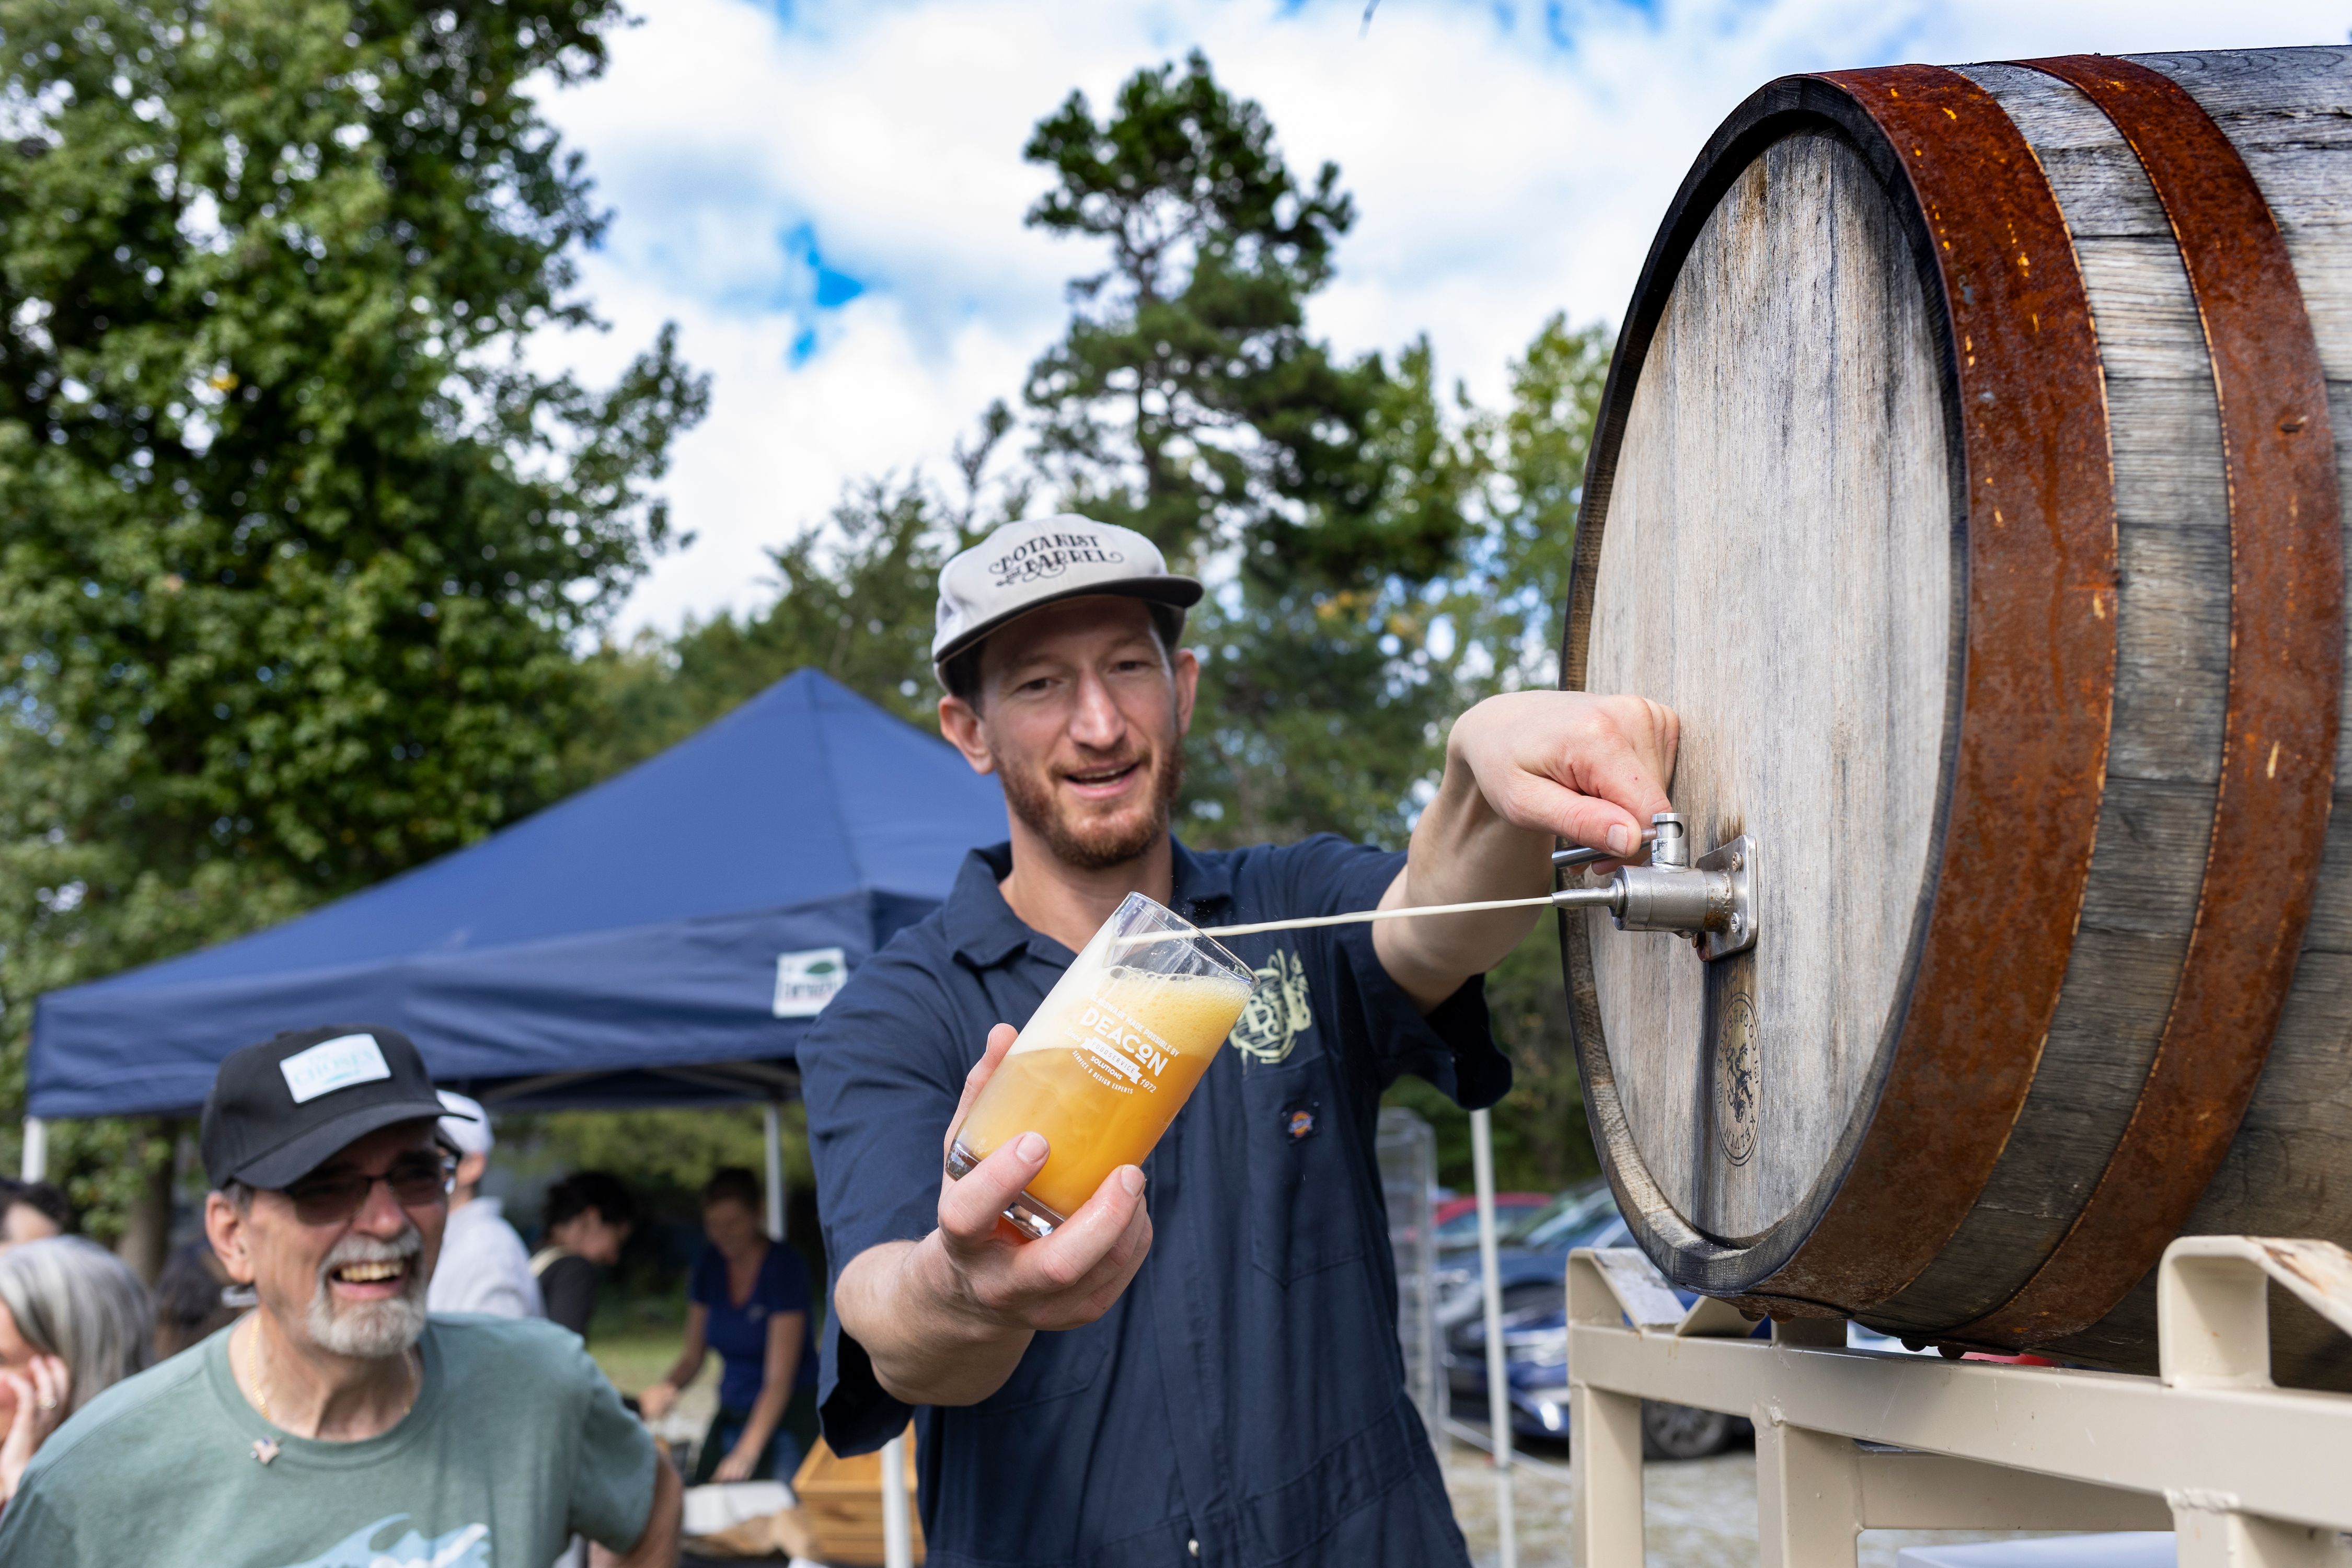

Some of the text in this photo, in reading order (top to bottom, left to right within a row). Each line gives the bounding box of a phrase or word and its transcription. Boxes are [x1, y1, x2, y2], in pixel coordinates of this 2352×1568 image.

[988, 534, 1099, 574] BOTANIST
[1022, 550, 1124, 582] BARREL
[1079, 1006, 1169, 1077] DEACON
[1125, 1016, 1145, 1032] MADE
[1143, 1028, 1171, 1052] POSSIBLE
[1170, 1047, 1180, 1057] BY
[1717, 1009, 1757, 1068] COOPERAGE
[1065, 1028, 1157, 1093] Since 1972
[1072, 1050, 1089, 1070] SERVICE
[1092, 1071, 1111, 1086] DESIGN
[1112, 1082, 1134, 1094] EXPERTS
[1090, 1055, 1123, 1080] SOLUTIONS
[1091, 1042, 1136, 1074] FOODSERVICE
[1724, 1113, 1756, 1150] KELVIN
